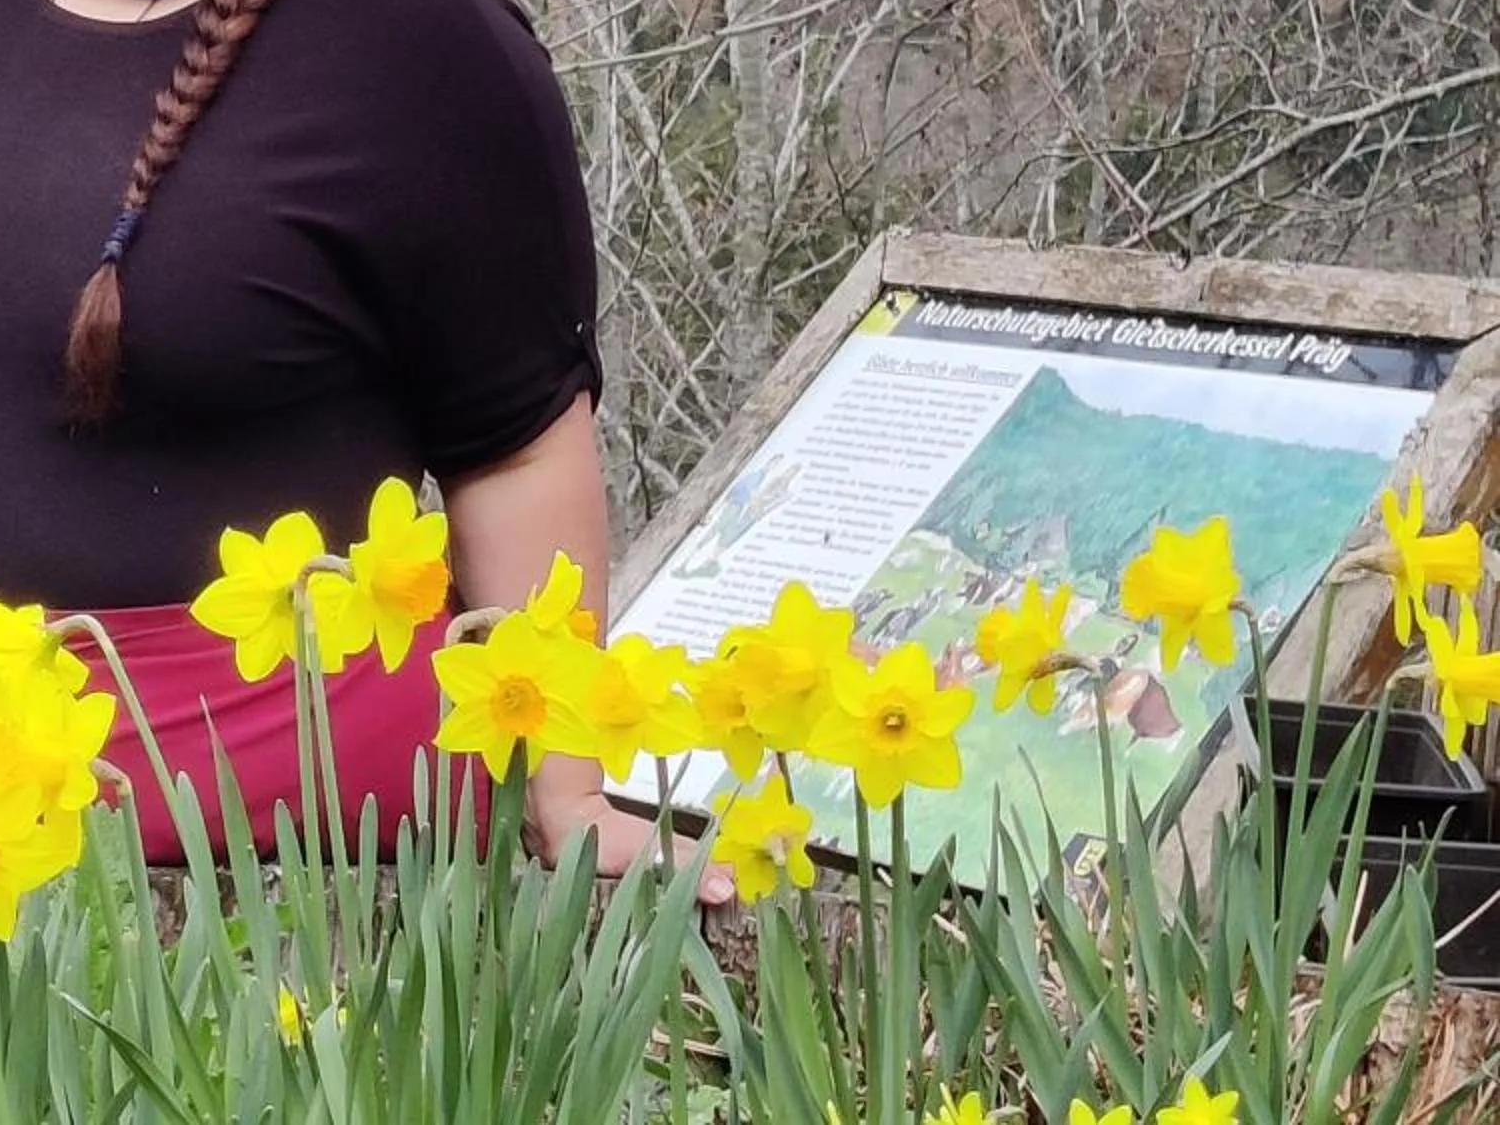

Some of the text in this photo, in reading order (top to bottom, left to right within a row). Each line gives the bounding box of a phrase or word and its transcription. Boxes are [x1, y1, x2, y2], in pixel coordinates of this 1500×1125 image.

[915, 298, 1352, 374] Naturschutzgebiet Gletscherkessel Präg
